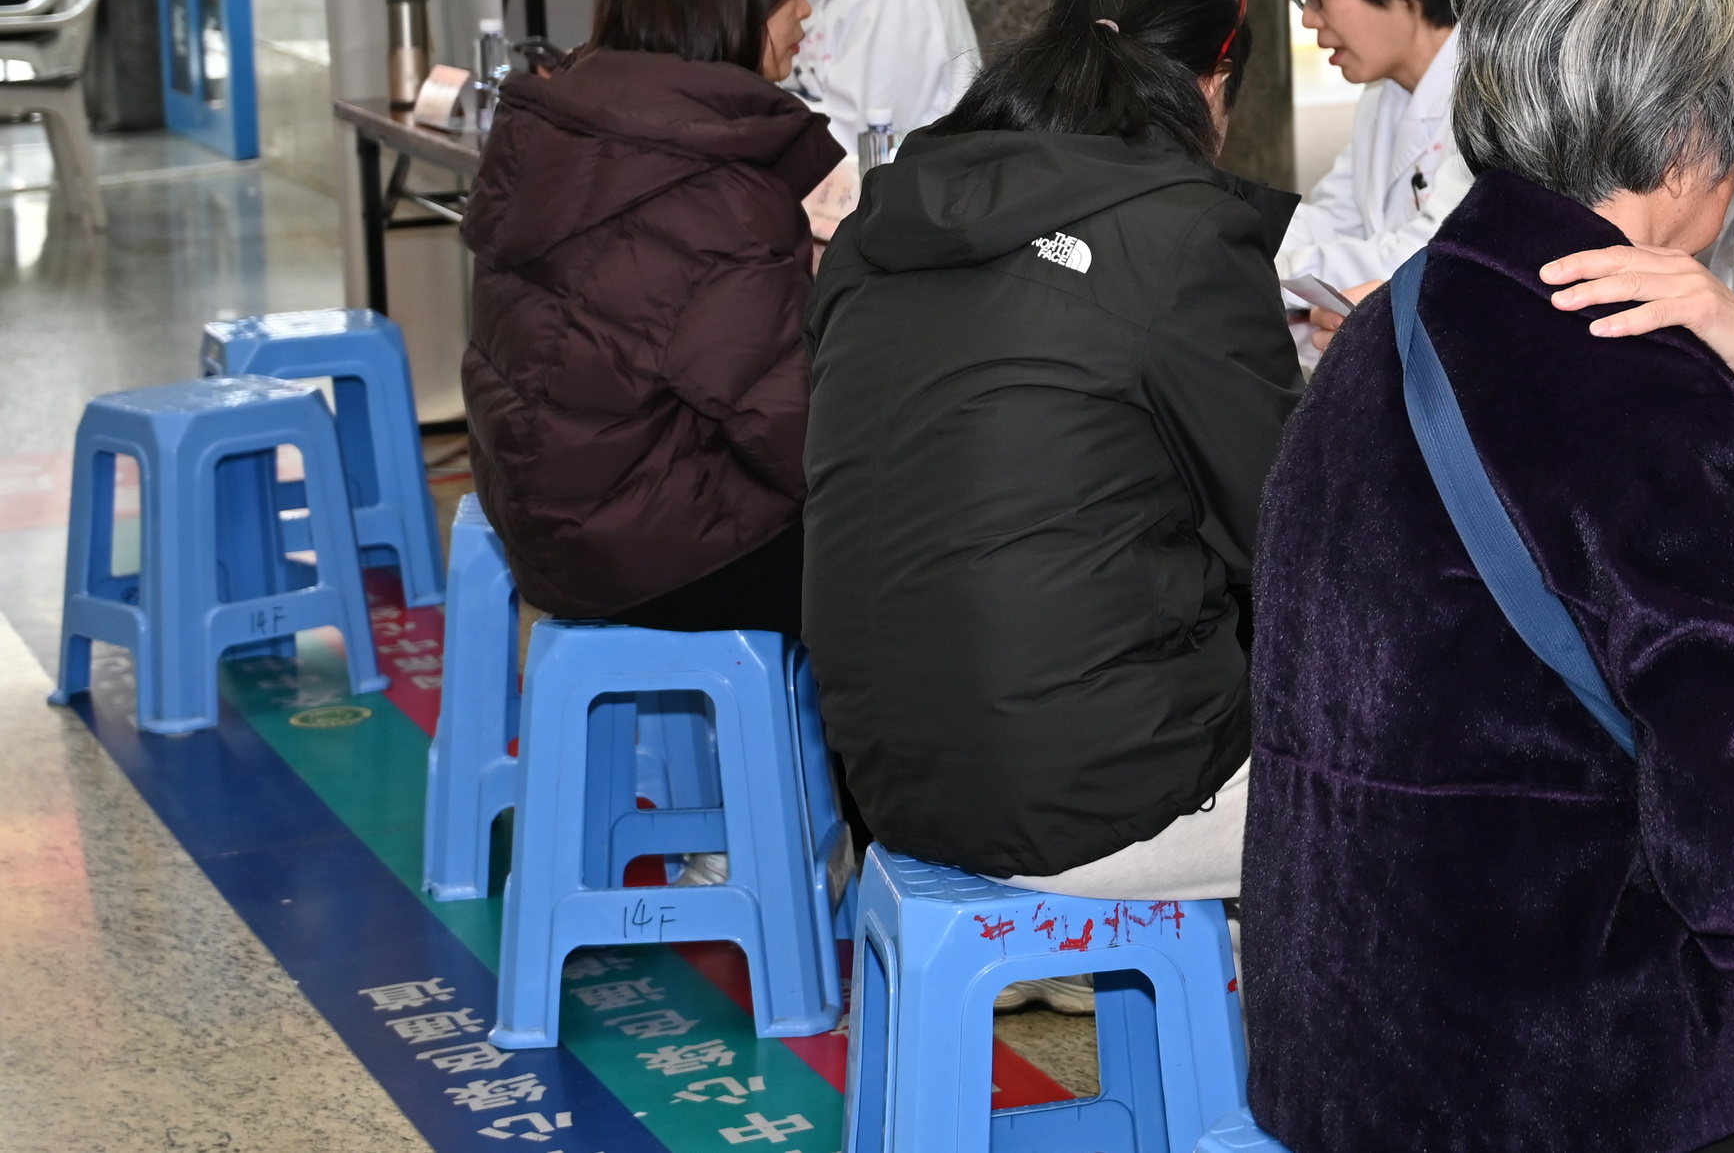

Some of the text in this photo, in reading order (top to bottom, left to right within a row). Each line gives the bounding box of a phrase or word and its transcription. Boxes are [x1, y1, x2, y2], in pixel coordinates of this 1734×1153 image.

[1031, 237, 1073, 258] NORTH
[1055, 231, 1078, 248] THE
[1037, 248, 1067, 266] FACE
[623, 898, 677, 942] 14F
[358, 977, 604, 1153] 心绿色通道
